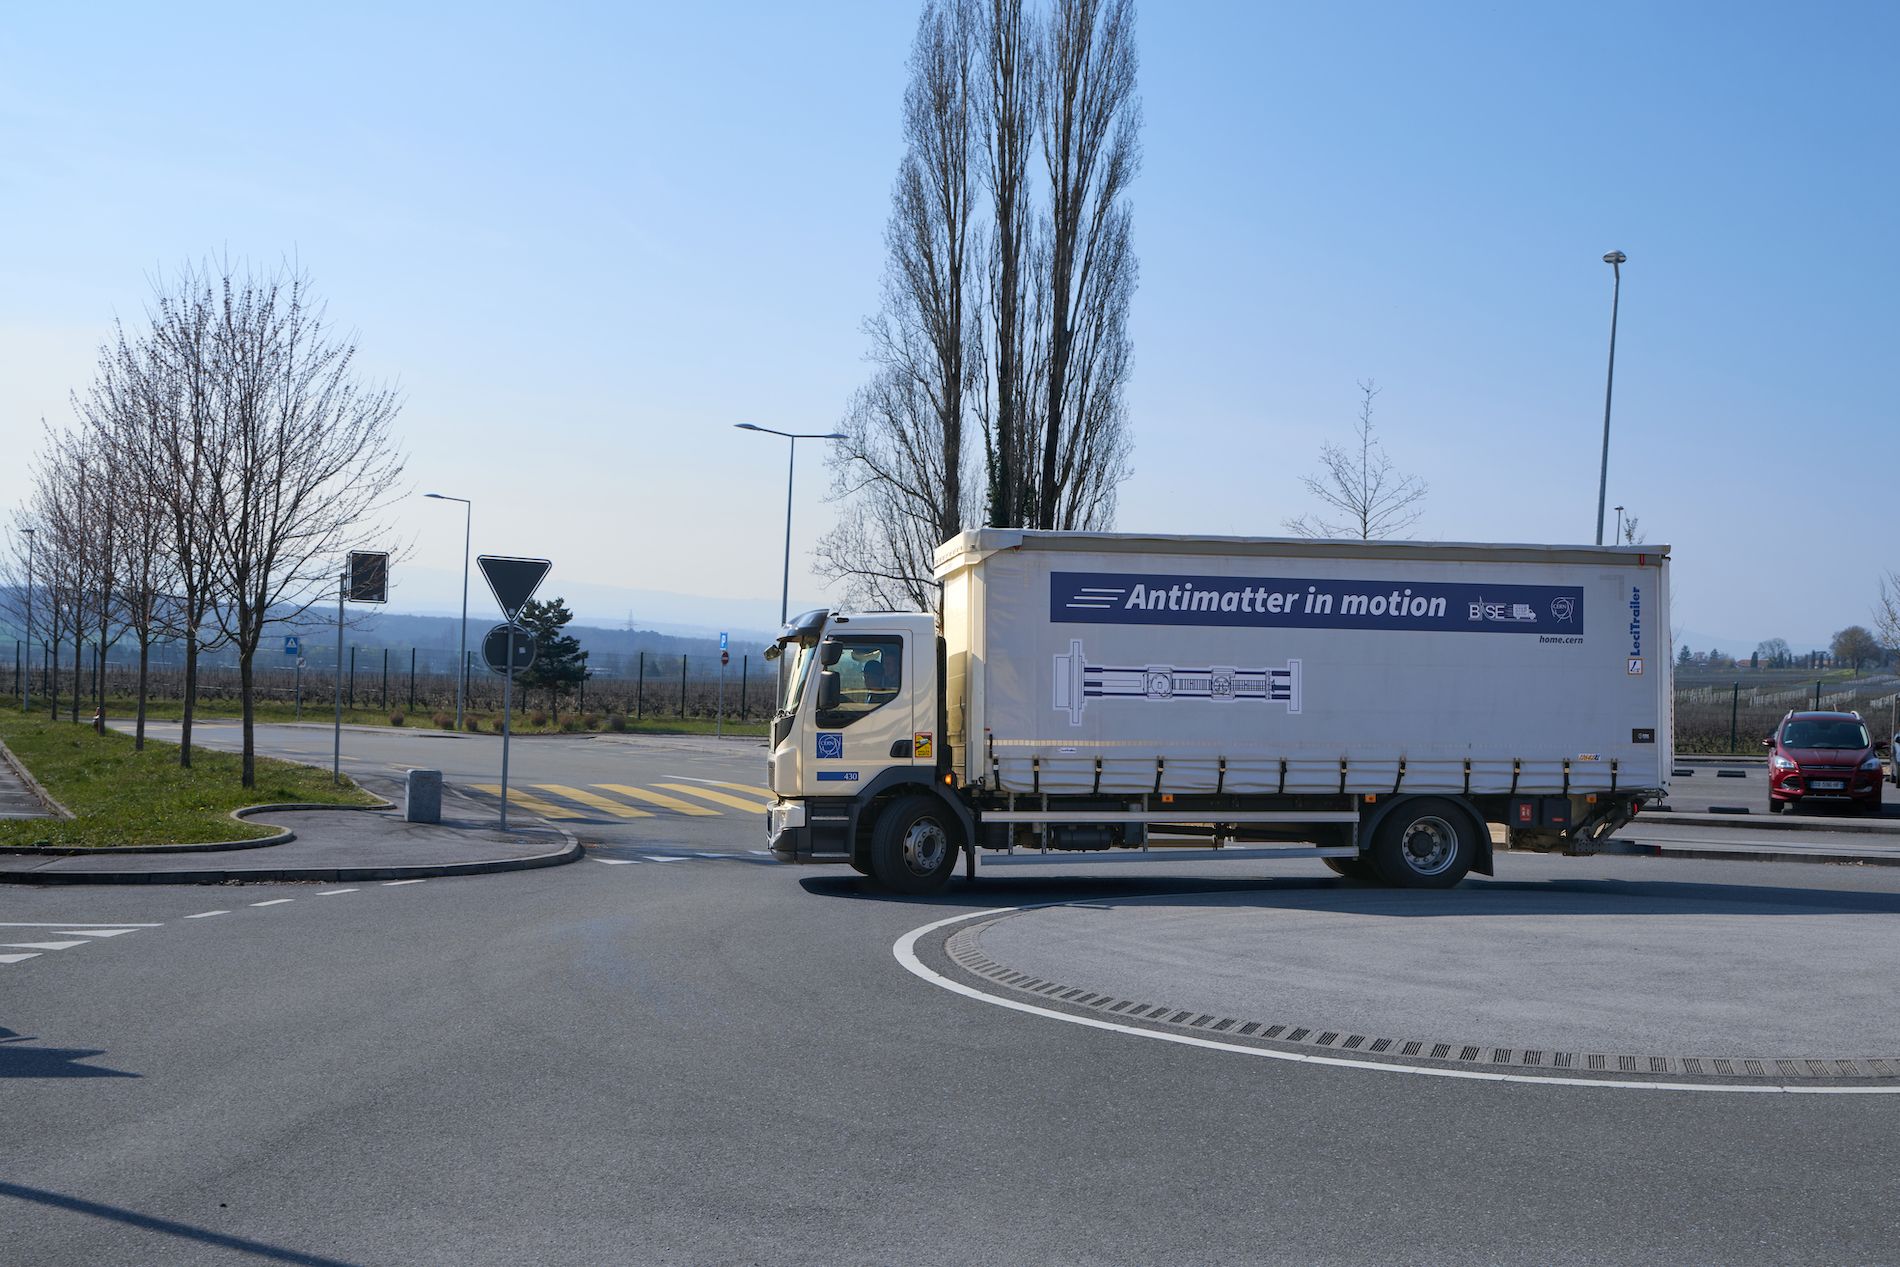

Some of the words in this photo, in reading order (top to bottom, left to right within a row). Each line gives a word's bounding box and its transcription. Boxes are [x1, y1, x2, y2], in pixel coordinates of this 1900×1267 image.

[1124, 583, 1300, 614] Antimatter
[1304, 585, 1334, 614] in
[1340, 588, 1447, 617] motion
[1629, 586, 1641, 657] LeciTrailer
[1539, 635, 1584, 644] home.cern
